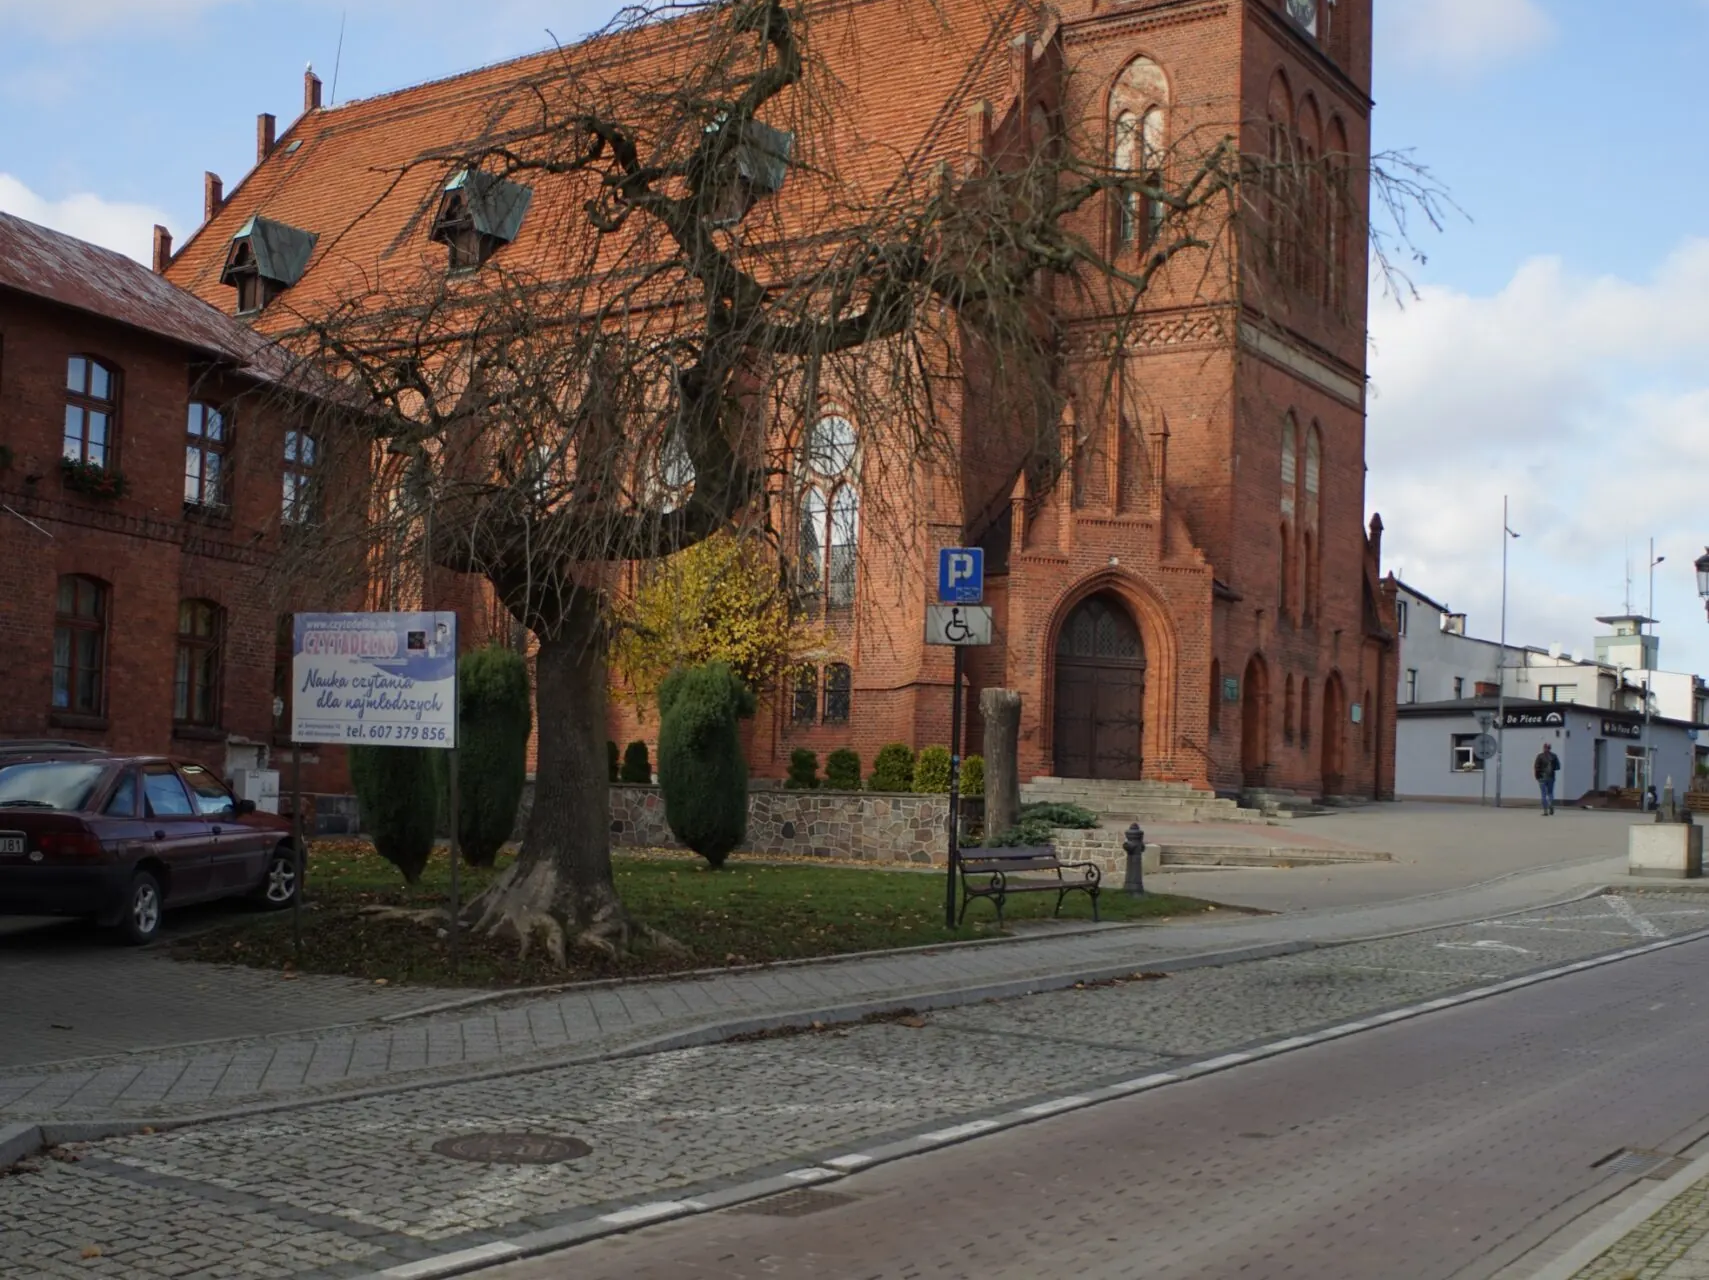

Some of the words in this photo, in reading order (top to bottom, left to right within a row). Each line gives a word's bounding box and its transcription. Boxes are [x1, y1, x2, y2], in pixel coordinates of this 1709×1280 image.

[948, 553, 974, 589] P
[302, 668, 349, 693] Nauka
[352, 672, 414, 697] czytania
[316, 690, 342, 709] dla
[345, 691, 443, 720] najmłodszych
[346, 724, 366, 737] tel.
[369, 725, 392, 739] 607
[394, 726, 418, 740] 379
[421, 727, 445, 741] 856
